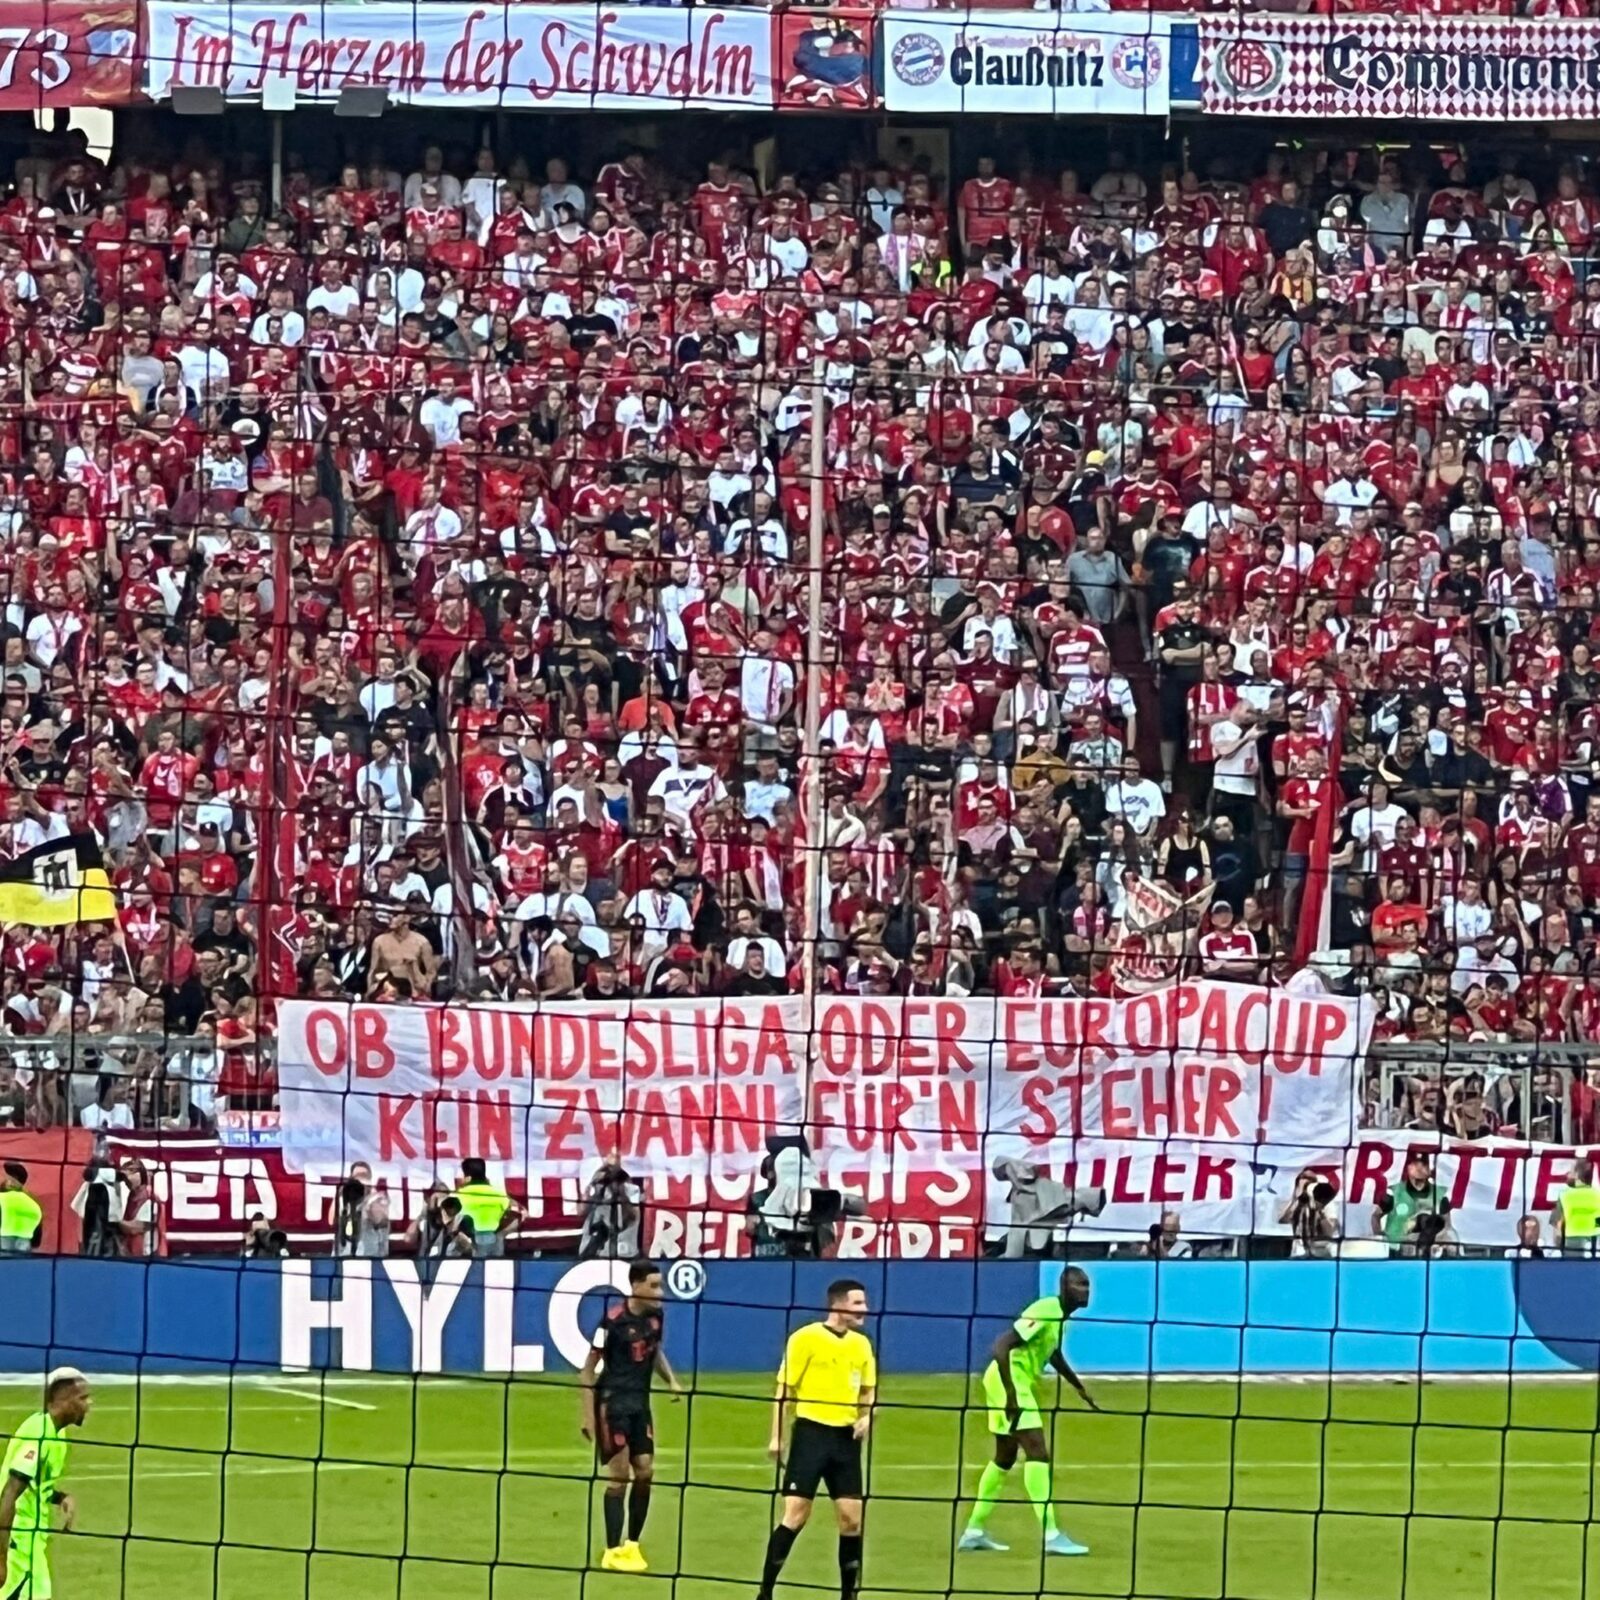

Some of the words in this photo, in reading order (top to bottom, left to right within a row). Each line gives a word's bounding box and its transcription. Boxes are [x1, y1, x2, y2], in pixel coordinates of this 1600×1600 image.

[170, 16, 234, 88] Im
[246, 14, 428, 92] Herzen
[440, 11, 522, 95] der
[529, 14, 755, 100] Schwalm
[949, 46, 1104, 87] Claußnitz
[306, 1008, 395, 1078] OB
[427, 1004, 795, 1080] BUNDESLIGA
[820, 1002, 975, 1076] ODER
[1006, 993, 1347, 1076] EUROPACUP
[378, 1089, 512, 1161] KEIN
[544, 1082, 777, 1160] ZWANNI
